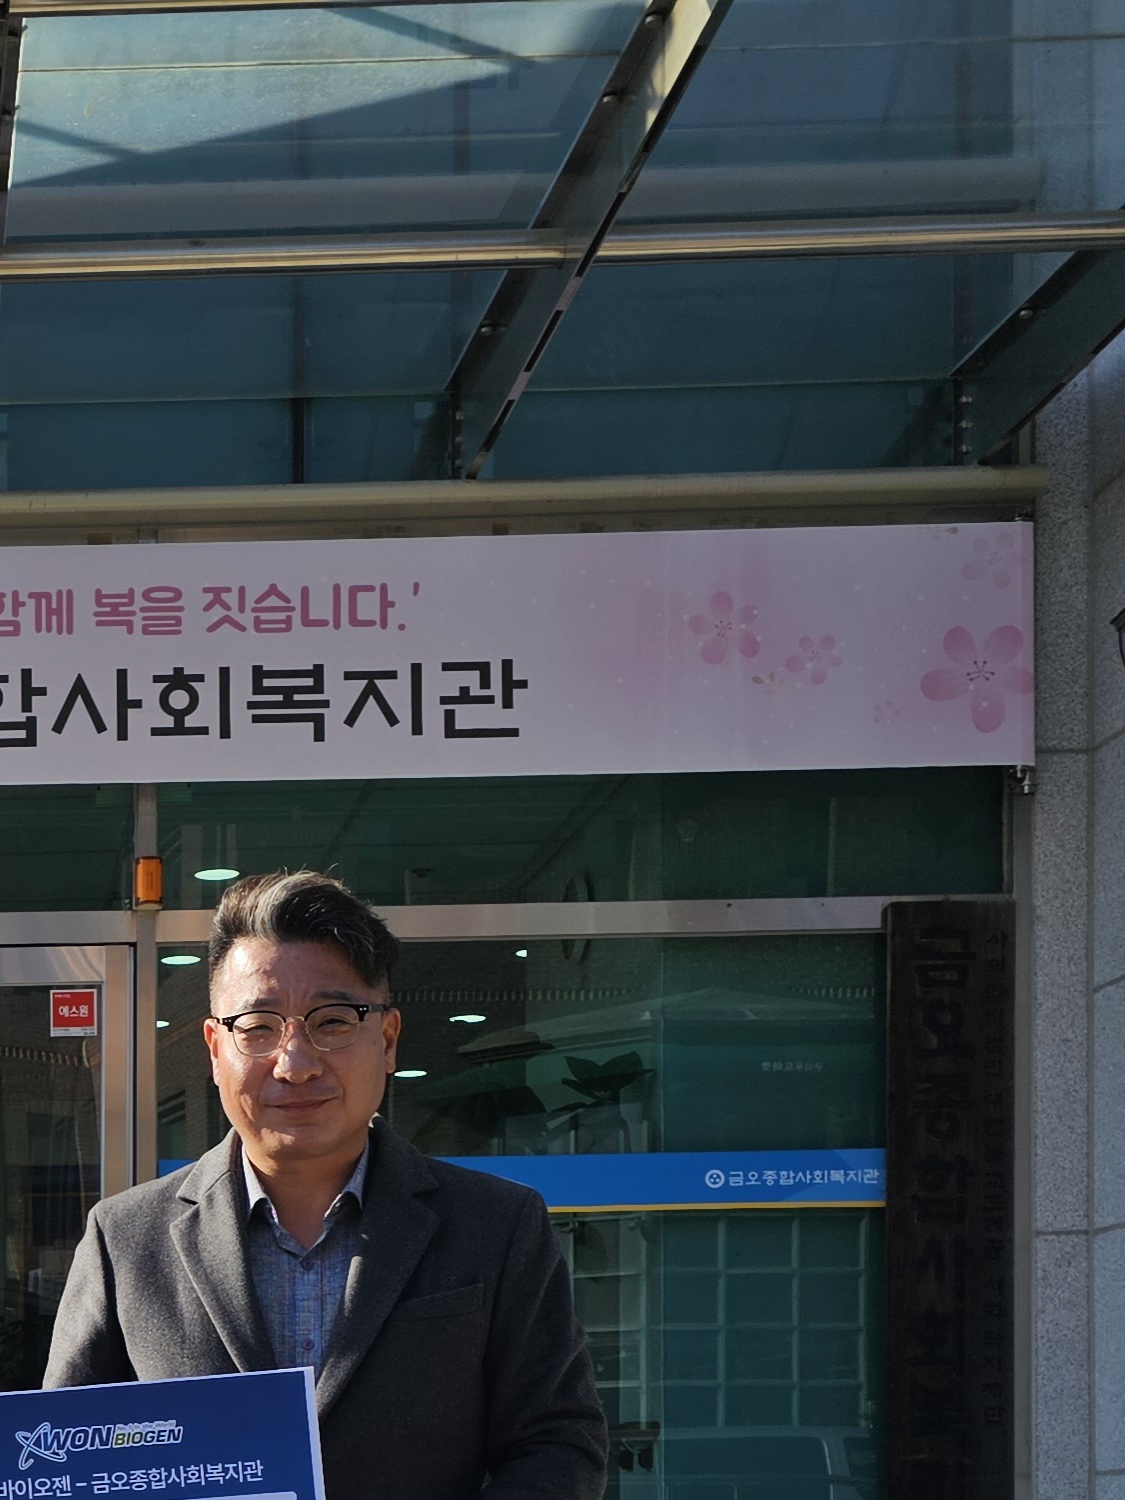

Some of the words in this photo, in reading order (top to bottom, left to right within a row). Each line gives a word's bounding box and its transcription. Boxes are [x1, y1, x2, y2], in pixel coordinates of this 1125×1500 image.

[92, 587, 186, 635] 복을
[58, 1005, 89, 1017] 에스원
[729, 1169, 879, 1186] 금오종합사회복지관
[42, 1425, 113, 1453] WON
[114, 1427, 183, 1447] BIOGEN
[91, 1460, 264, 1494] 금오종합사회복지관
